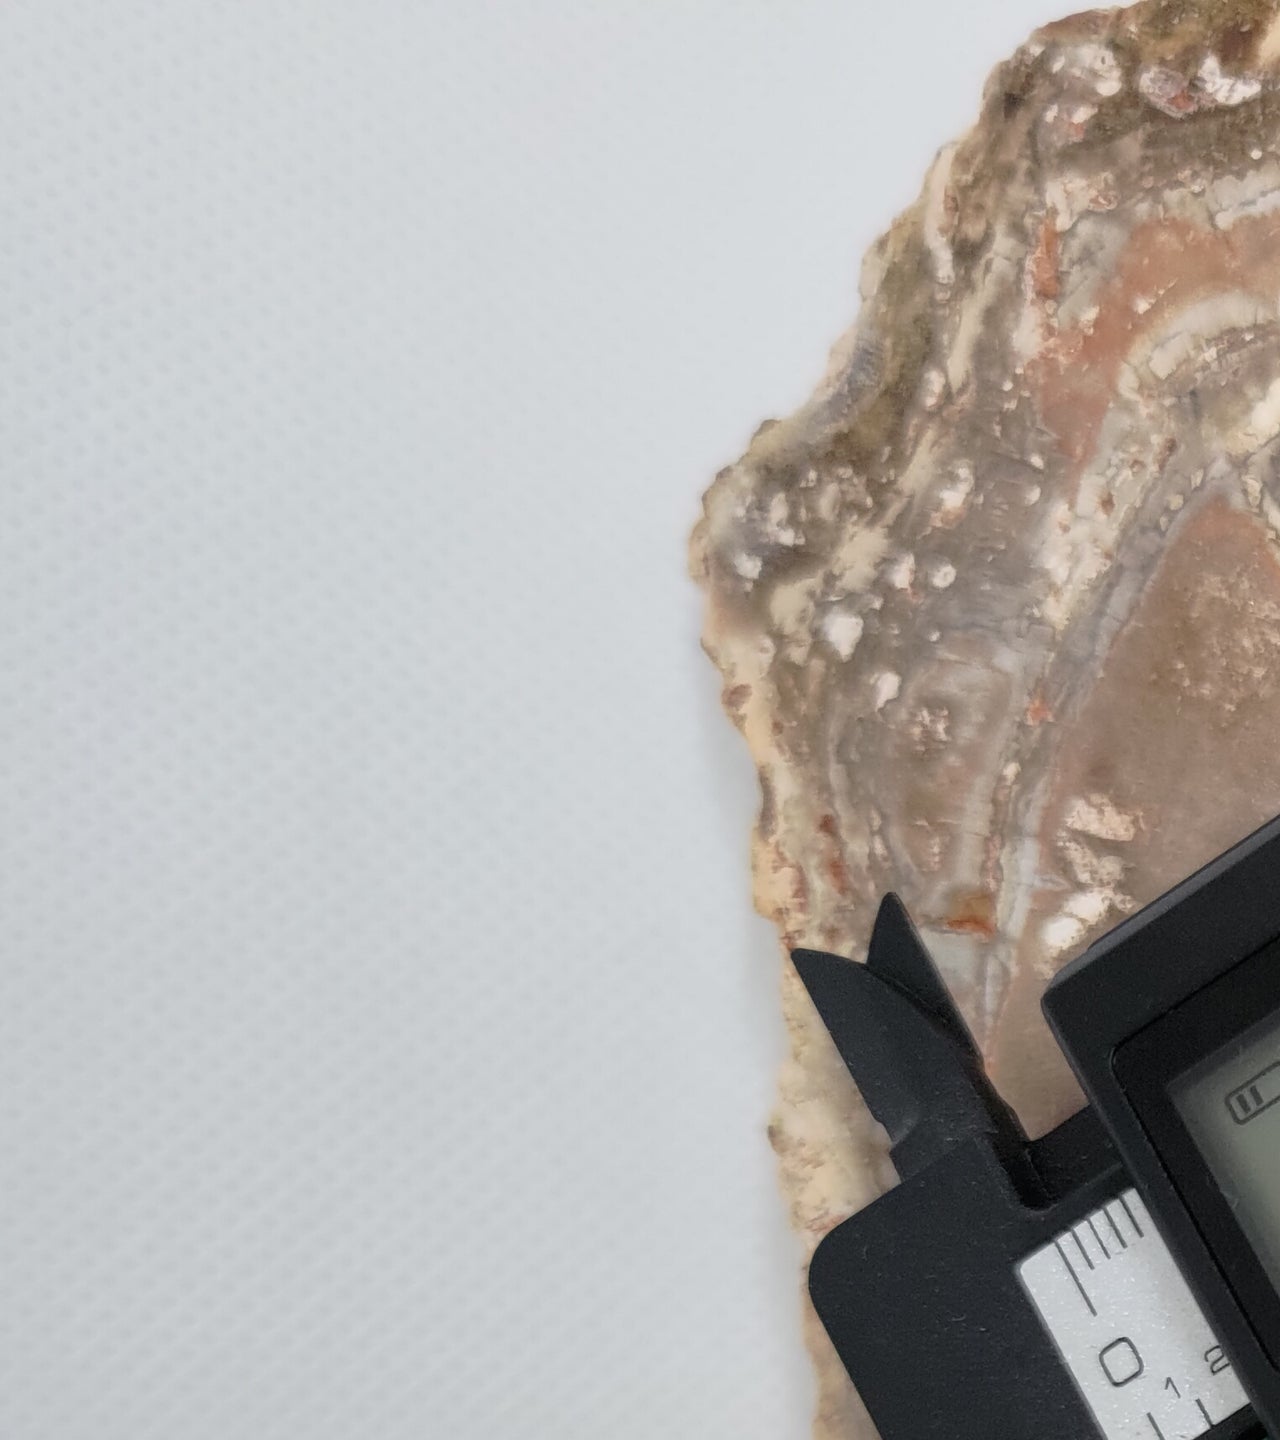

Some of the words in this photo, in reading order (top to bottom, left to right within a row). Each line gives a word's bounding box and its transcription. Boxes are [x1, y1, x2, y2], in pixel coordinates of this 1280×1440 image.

[1099, 1337, 1145, 1387] 0
[1165, 1377, 1181, 1399] 1
[1204, 1345, 1231, 1376] 2
